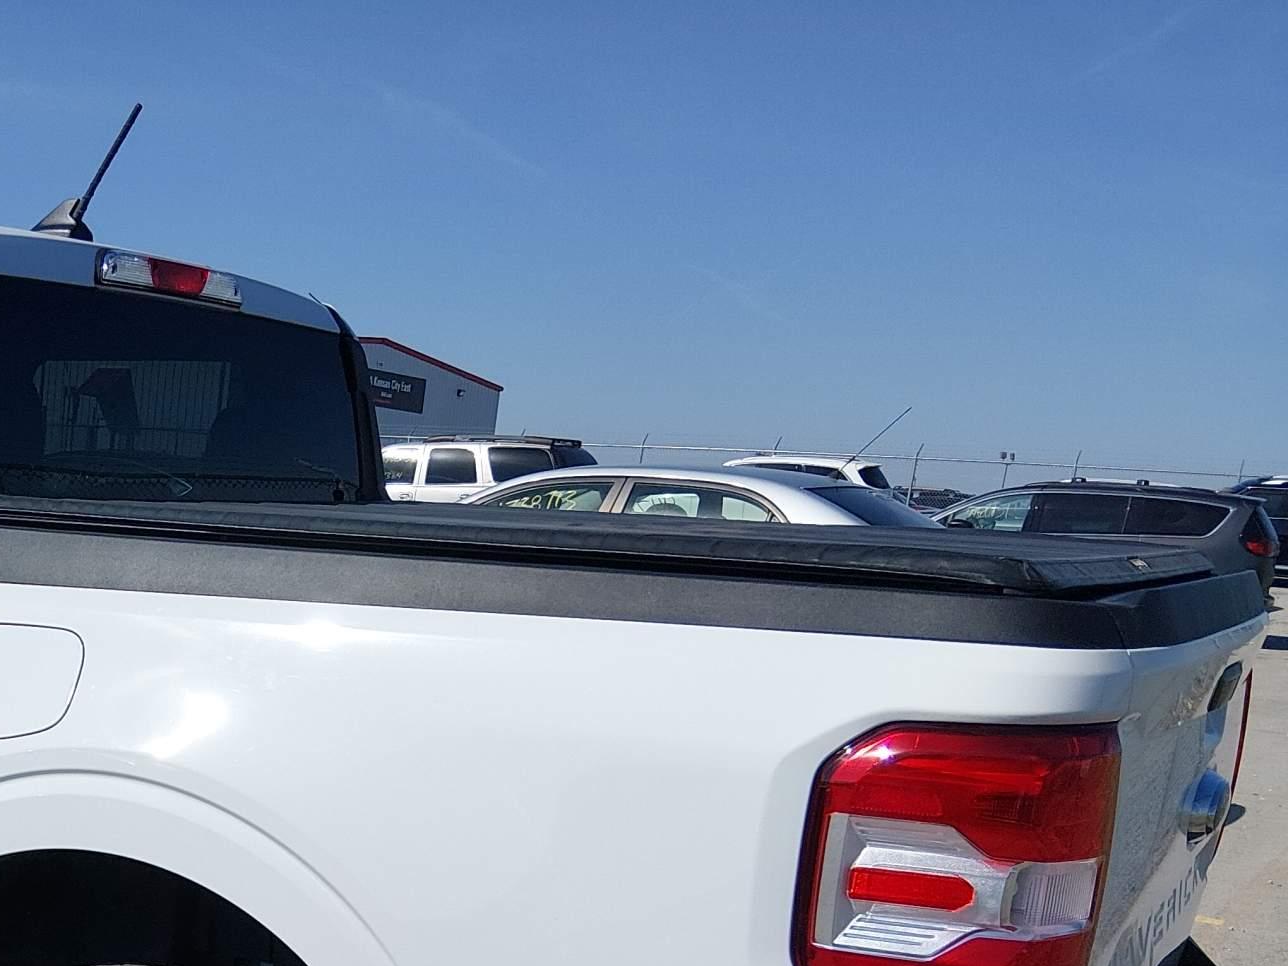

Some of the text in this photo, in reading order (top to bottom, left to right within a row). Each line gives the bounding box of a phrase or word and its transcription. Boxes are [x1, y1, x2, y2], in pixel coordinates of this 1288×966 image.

[374, 376, 391, 389] Kansas
[392, 379, 401, 393] City
[401, 381, 412, 393] East
